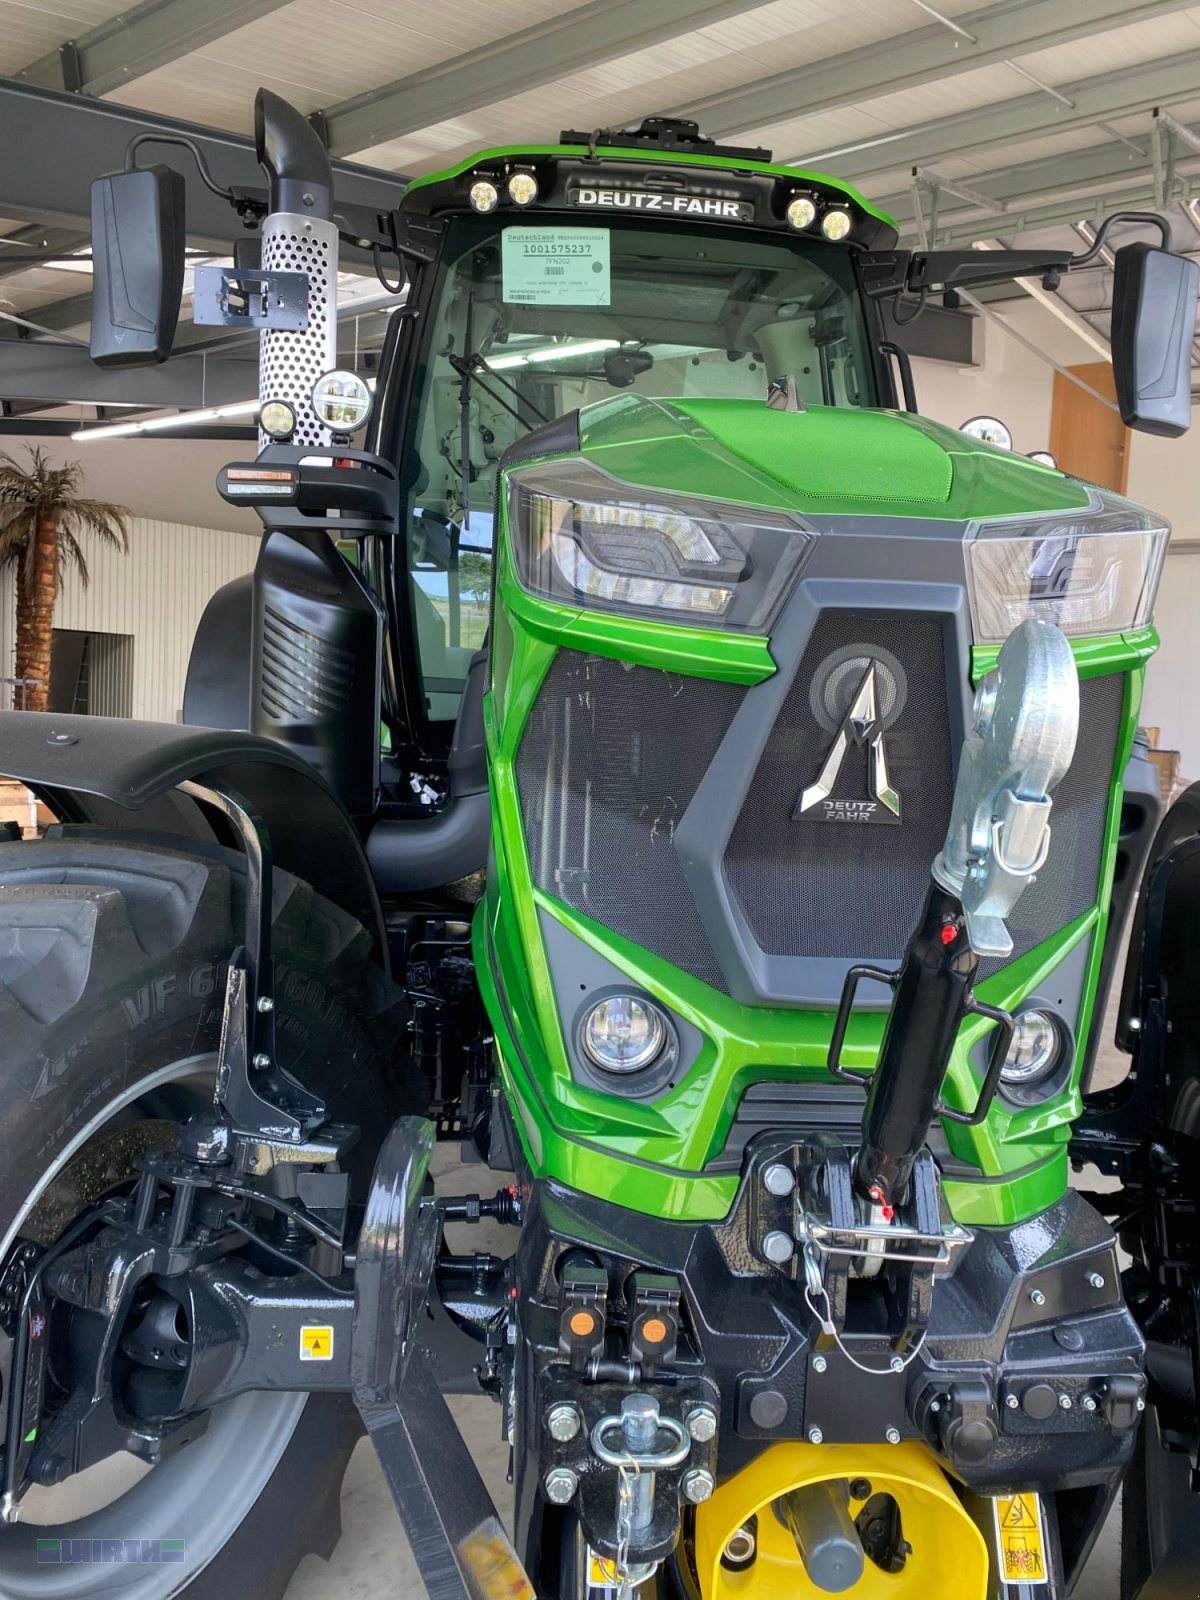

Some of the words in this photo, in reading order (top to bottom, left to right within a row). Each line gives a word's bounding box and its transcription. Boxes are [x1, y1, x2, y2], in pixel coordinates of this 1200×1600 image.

[579, 189, 739, 217] DEUTZ-FAHR
[524, 244, 592, 254] 1001575237
[823, 801, 878, 812] DEUTZ
[826, 811, 870, 821] FAHR
